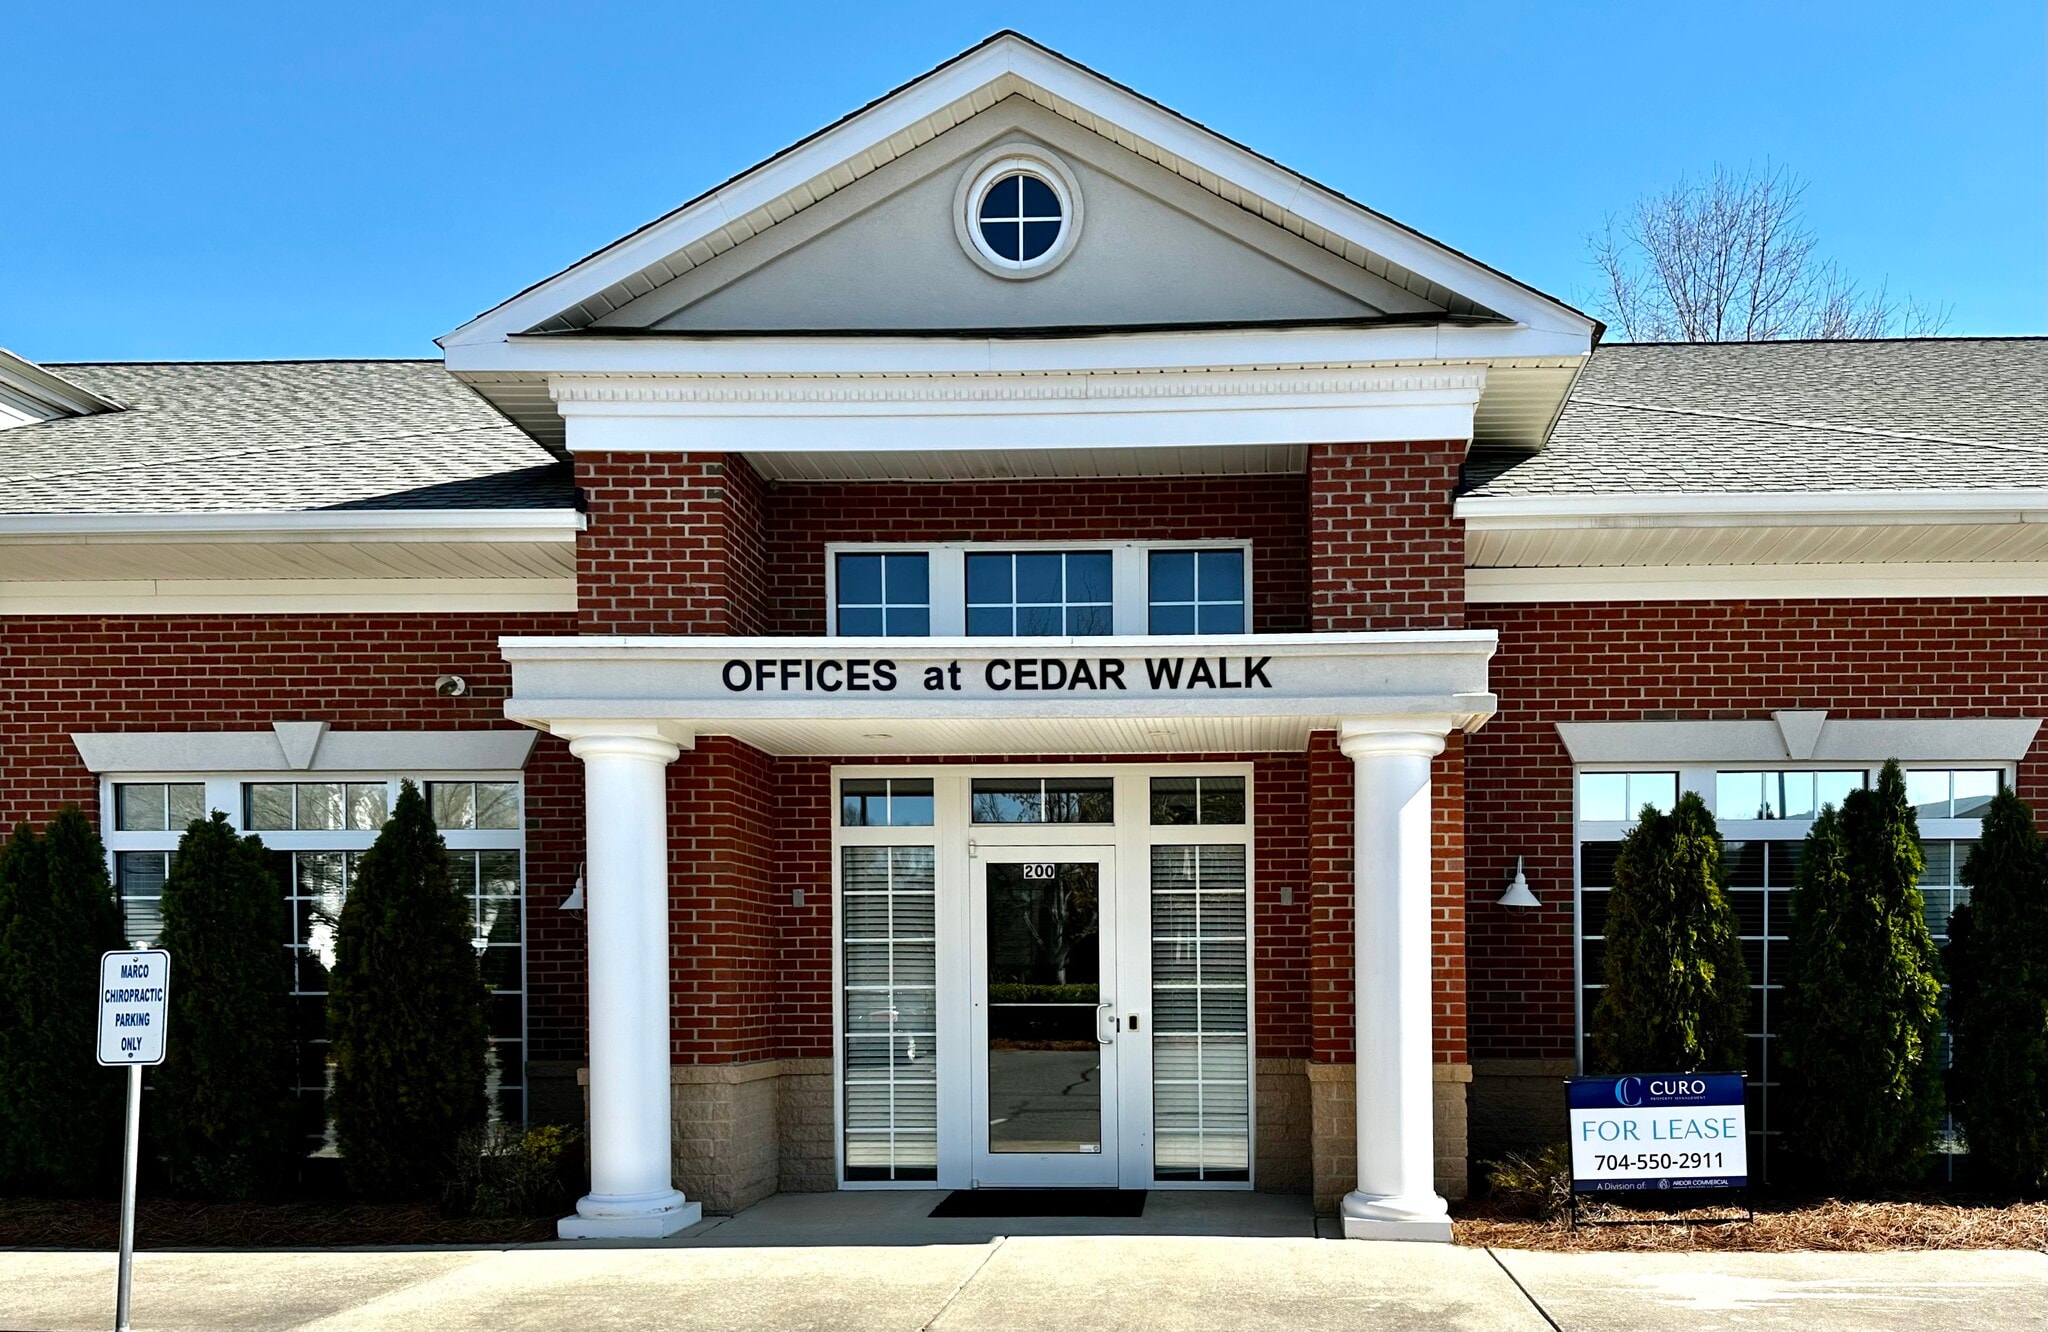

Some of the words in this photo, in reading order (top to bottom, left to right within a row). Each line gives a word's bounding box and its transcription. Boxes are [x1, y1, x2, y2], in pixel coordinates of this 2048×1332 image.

[721, 659, 897, 691] OFFICES
[923, 660, 962, 691] at
[984, 658, 1127, 690] CEDAR
[1145, 656, 1273, 689] WALK
[1025, 864, 1054, 878] 200
[120, 964, 149, 979] MARCO
[105, 988, 163, 1003] CHIROPRACTIC
[115, 1012, 150, 1027] PARKING
[121, 1037, 142, 1051] ONLY
[1650, 1080, 1706, 1095] CURO
[1583, 1120, 1640, 1142] FOR
[1653, 1118, 1737, 1140] LEASE
[1594, 1152, 1723, 1171] 704-550-2911
[1597, 1183, 1603, 1191] A
[1605, 1182, 1634, 1190] Division
